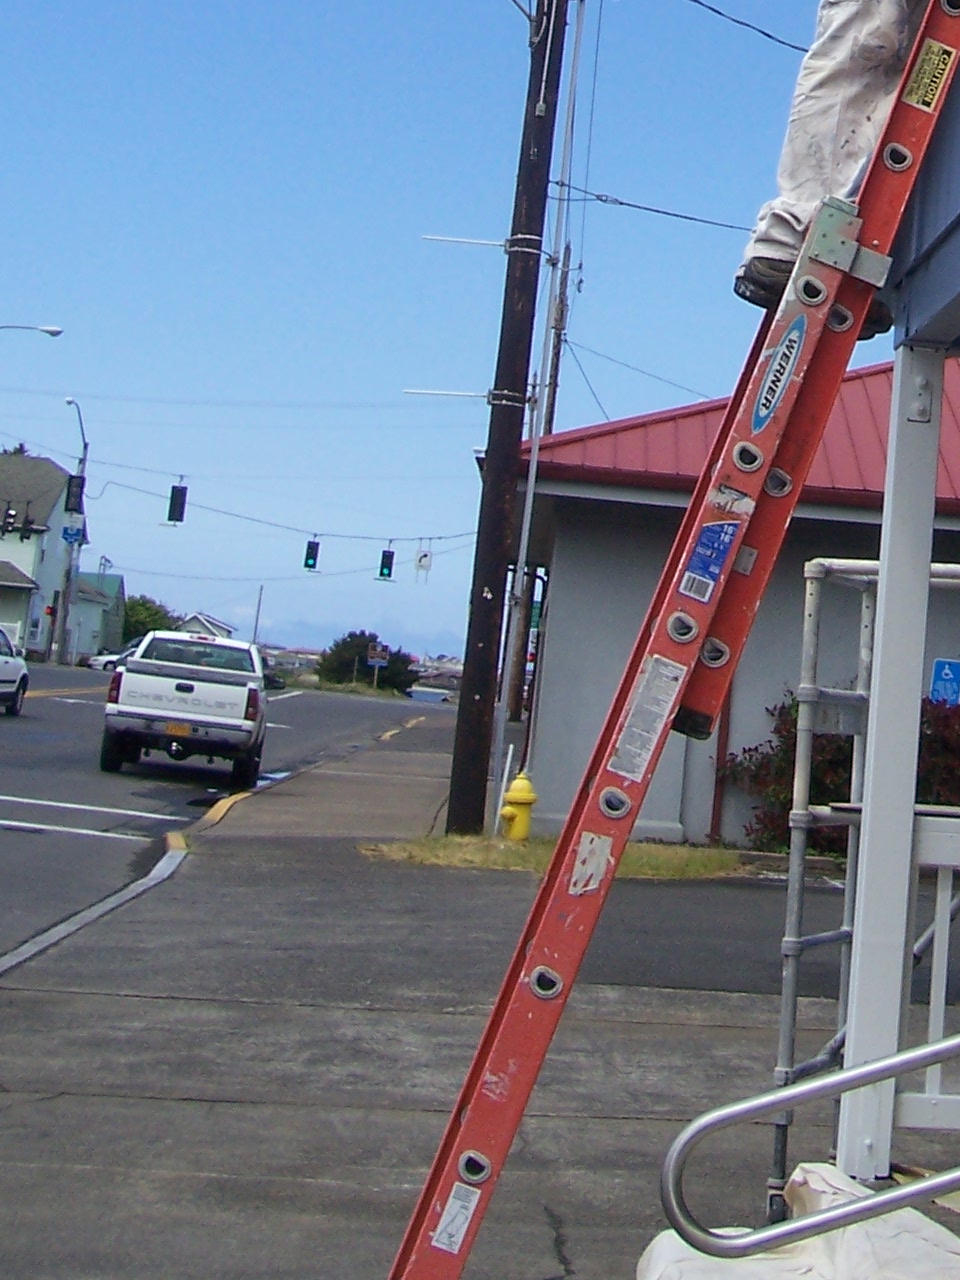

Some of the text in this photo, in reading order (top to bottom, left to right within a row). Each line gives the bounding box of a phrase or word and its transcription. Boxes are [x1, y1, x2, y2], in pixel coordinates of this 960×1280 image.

[925, 55, 951, 102] CAUTION
[760, 337, 798, 412] WERNER
[127, 690, 239, 710] CHEVROLET
